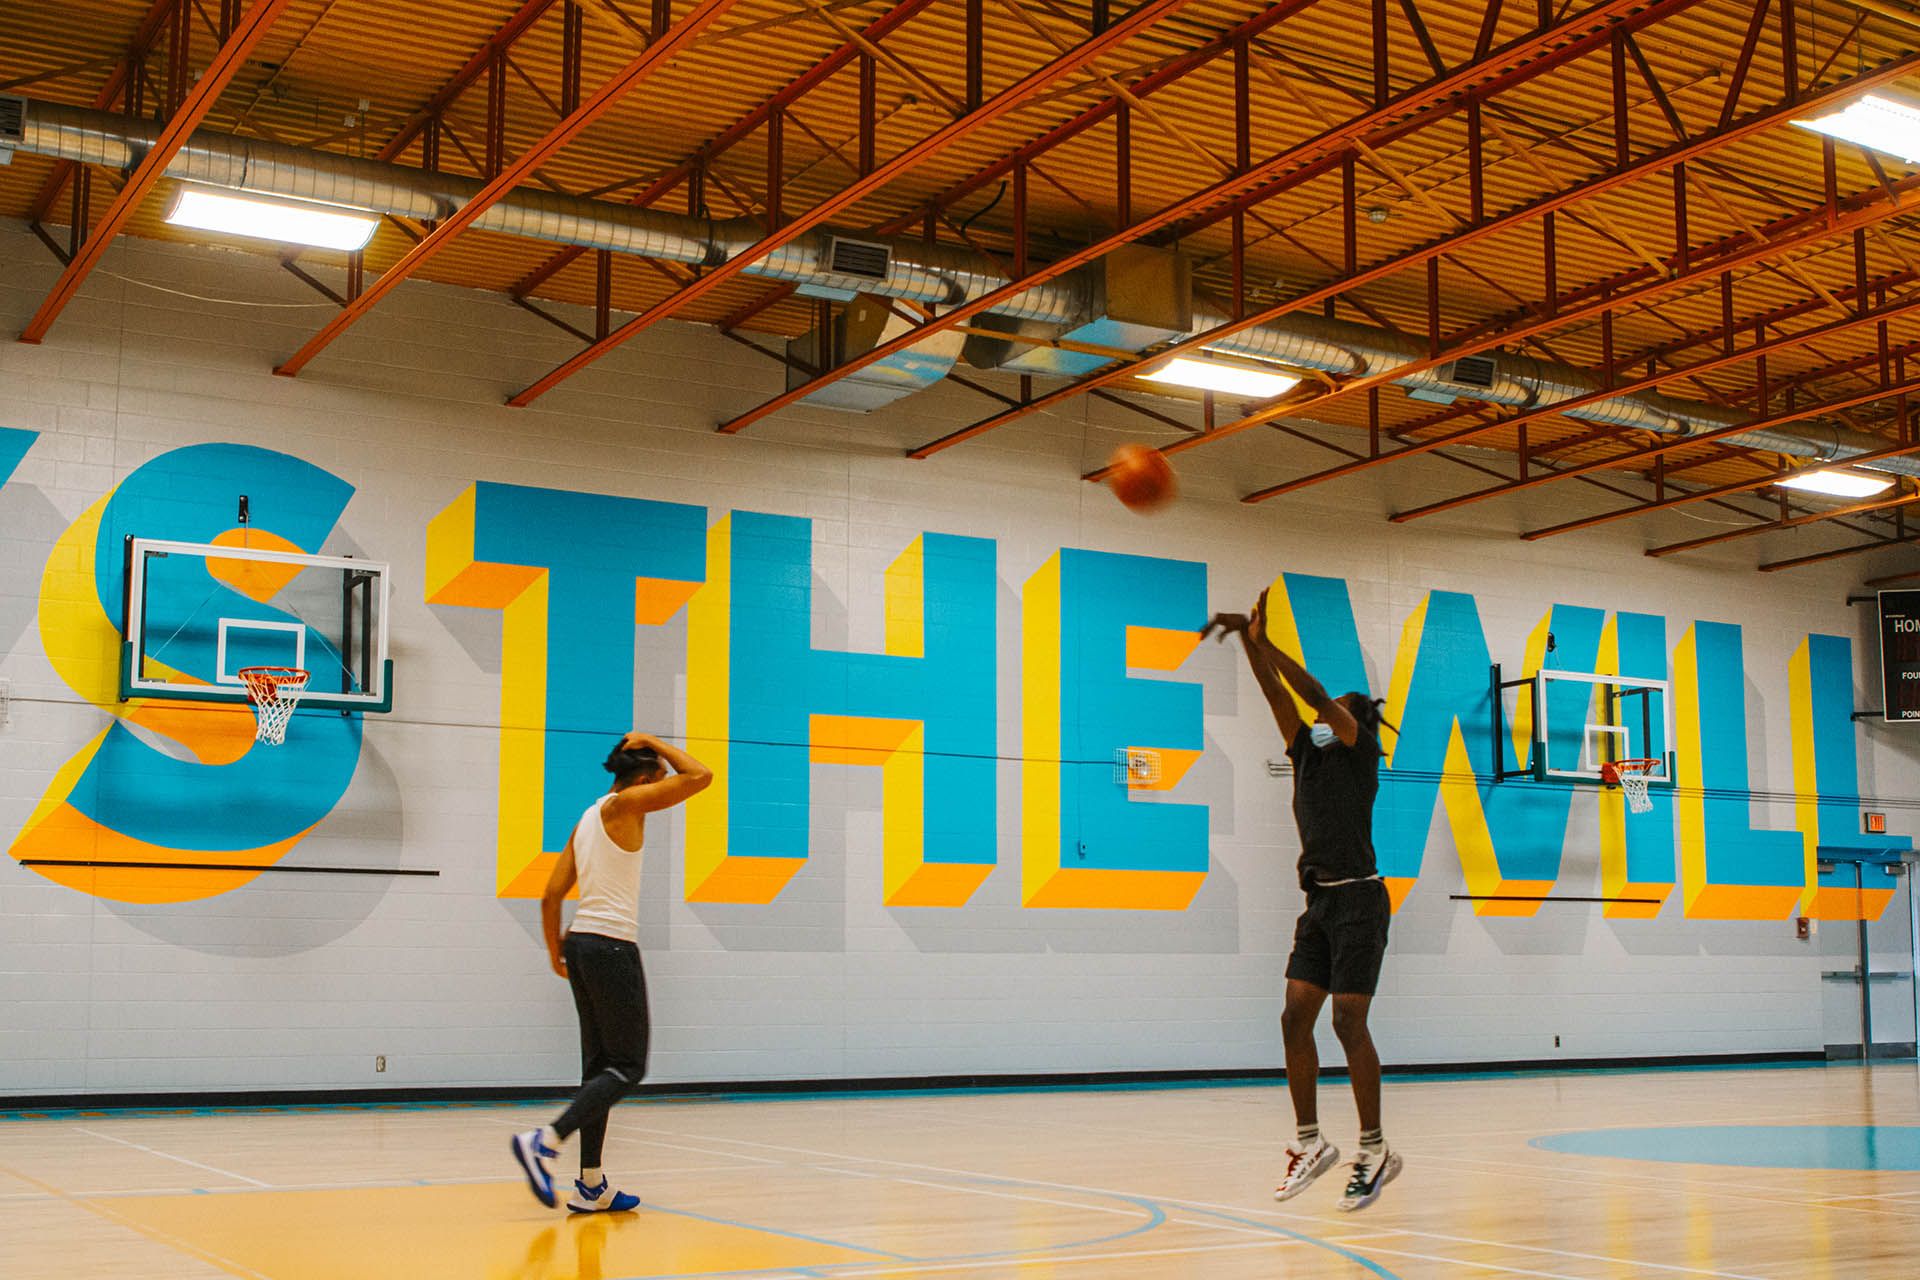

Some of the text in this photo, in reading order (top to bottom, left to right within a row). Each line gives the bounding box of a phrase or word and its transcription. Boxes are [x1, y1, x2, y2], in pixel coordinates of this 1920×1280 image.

[0, 426, 1912, 921] S THE WILL
[1902, 671, 1920, 680] FOU
